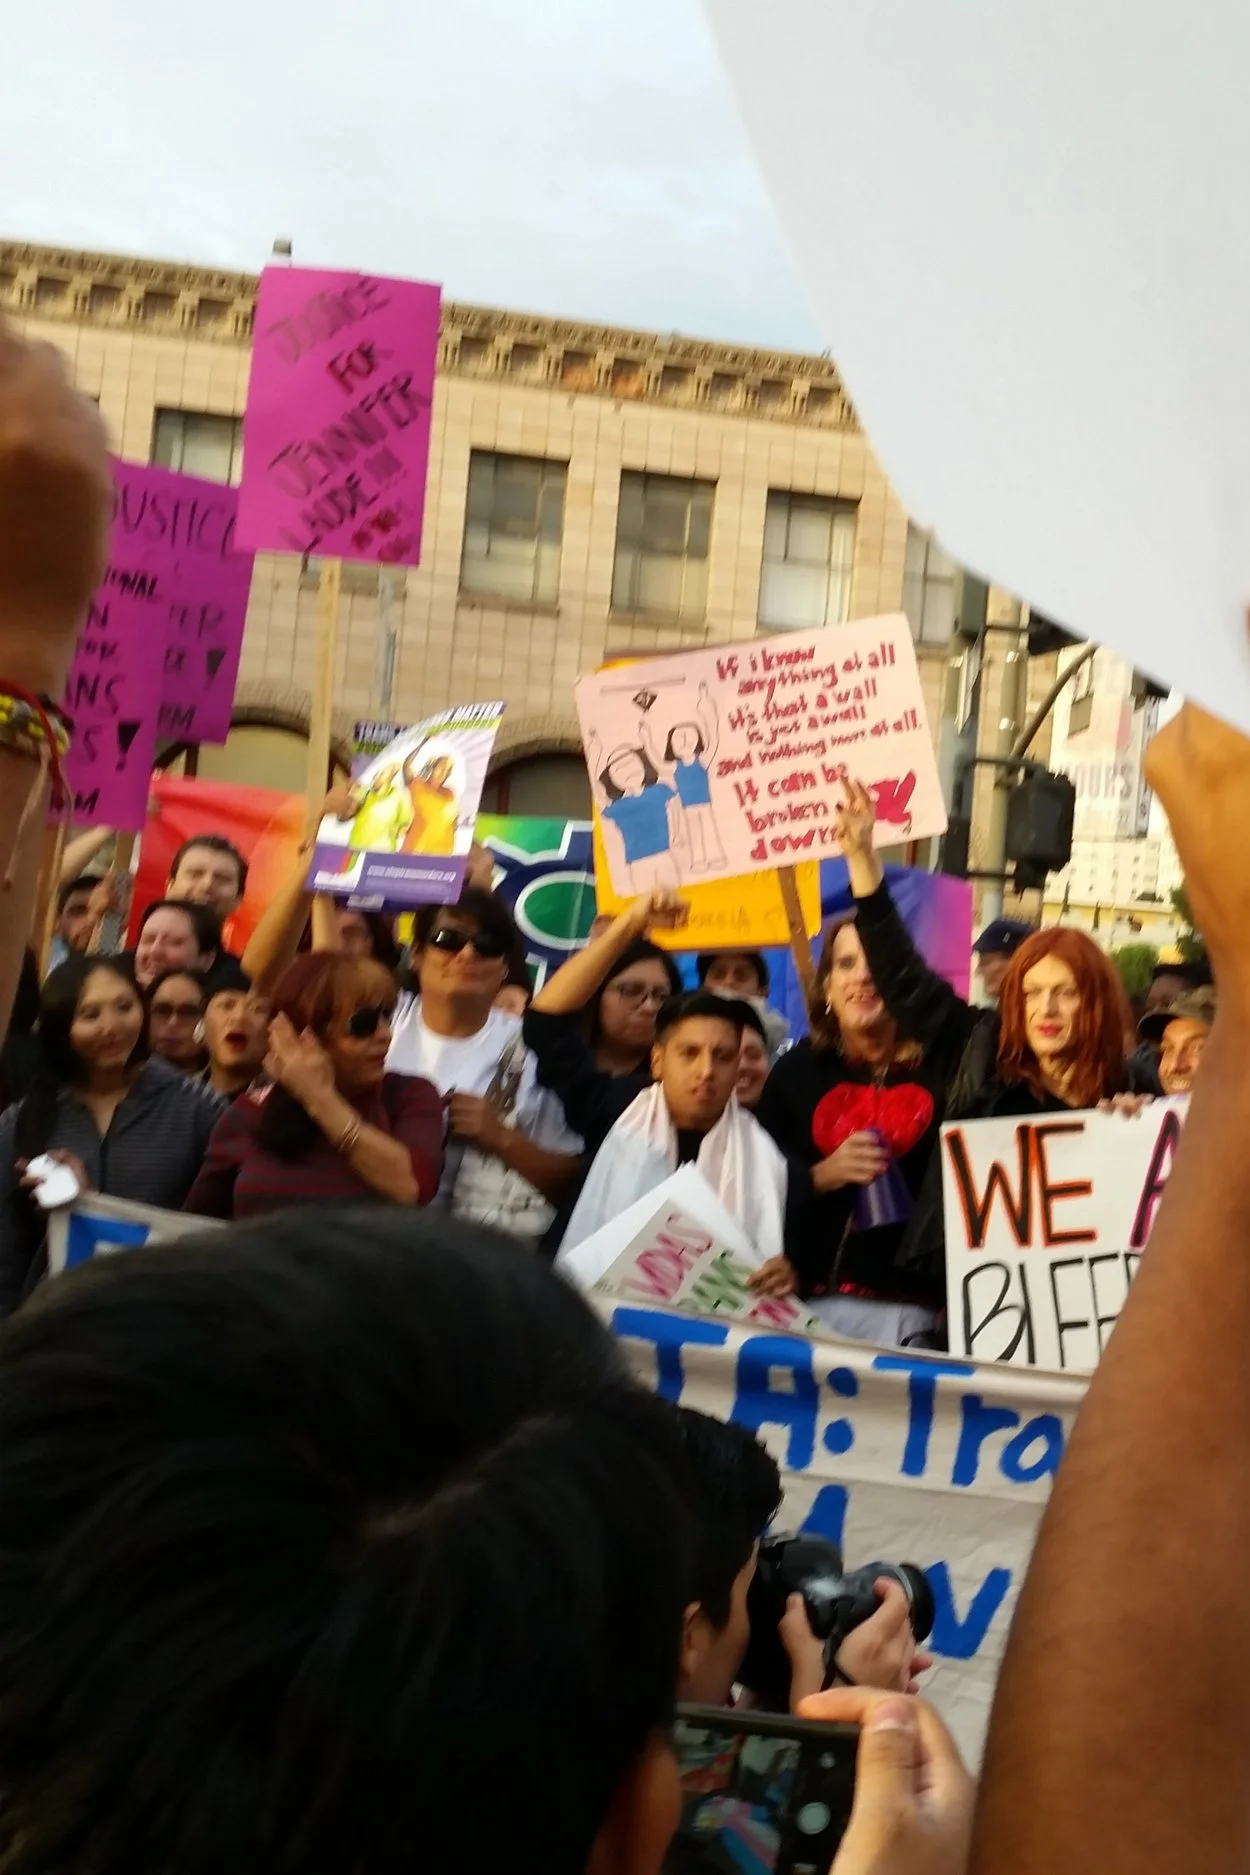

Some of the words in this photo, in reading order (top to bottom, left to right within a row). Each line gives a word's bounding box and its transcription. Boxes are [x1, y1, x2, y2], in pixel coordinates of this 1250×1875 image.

[326, 339, 396, 394] FOR
[738, 663, 838, 706] anything
[842, 651, 862, 674] at
[868, 641, 896, 668] all
[763, 693, 808, 721] that
[815, 693, 828, 710] a
[833, 676, 878, 703] wall
[807, 713, 819, 729] a
[822, 704, 867, 726] wall
[767, 770, 817, 797] can
[746, 801, 829, 834] broken
[944, 1119, 1098, 1251] WE
